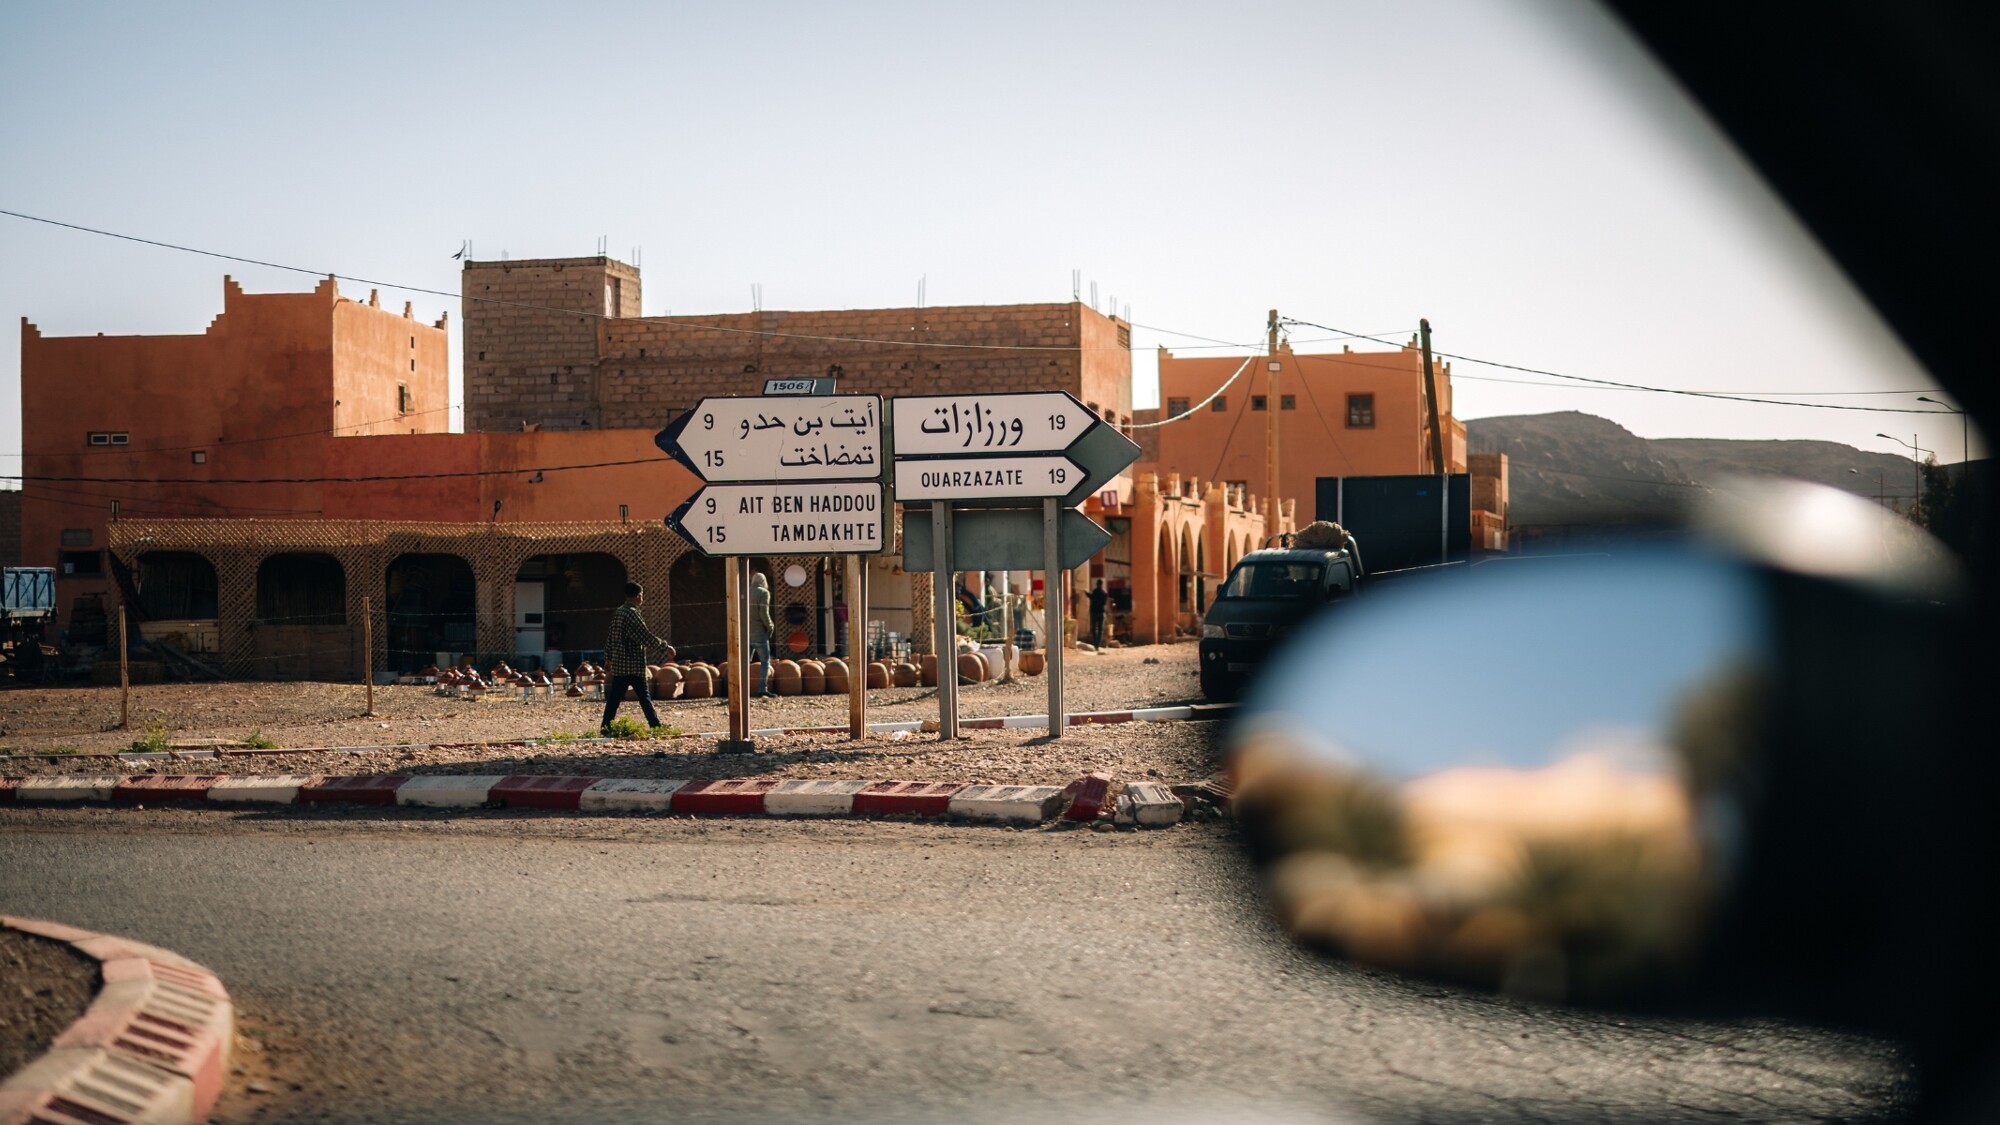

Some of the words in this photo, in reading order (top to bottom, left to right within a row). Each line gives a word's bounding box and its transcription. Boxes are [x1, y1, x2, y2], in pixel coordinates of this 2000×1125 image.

[703, 413, 714, 431] 9
[740, 413, 786, 440] حدو
[793, 416, 824, 437] بن
[830, 402, 874, 436] أيت
[920, 401, 1024, 448] ورزازات
[1048, 414, 1066, 431] 19
[704, 449, 725, 468] 15
[780, 443, 875, 467] تمضاخت
[921, 469, 1023, 488] OUARZAZATE
[1048, 468, 1066, 485] 19
[706, 497, 717, 515] 9
[738, 496, 764, 514] AIT
[772, 495, 803, 514] BEN
[810, 494, 876, 513] HADDOU
[706, 525, 727, 544] 15
[771, 522, 876, 542] TAMDAKHTE
